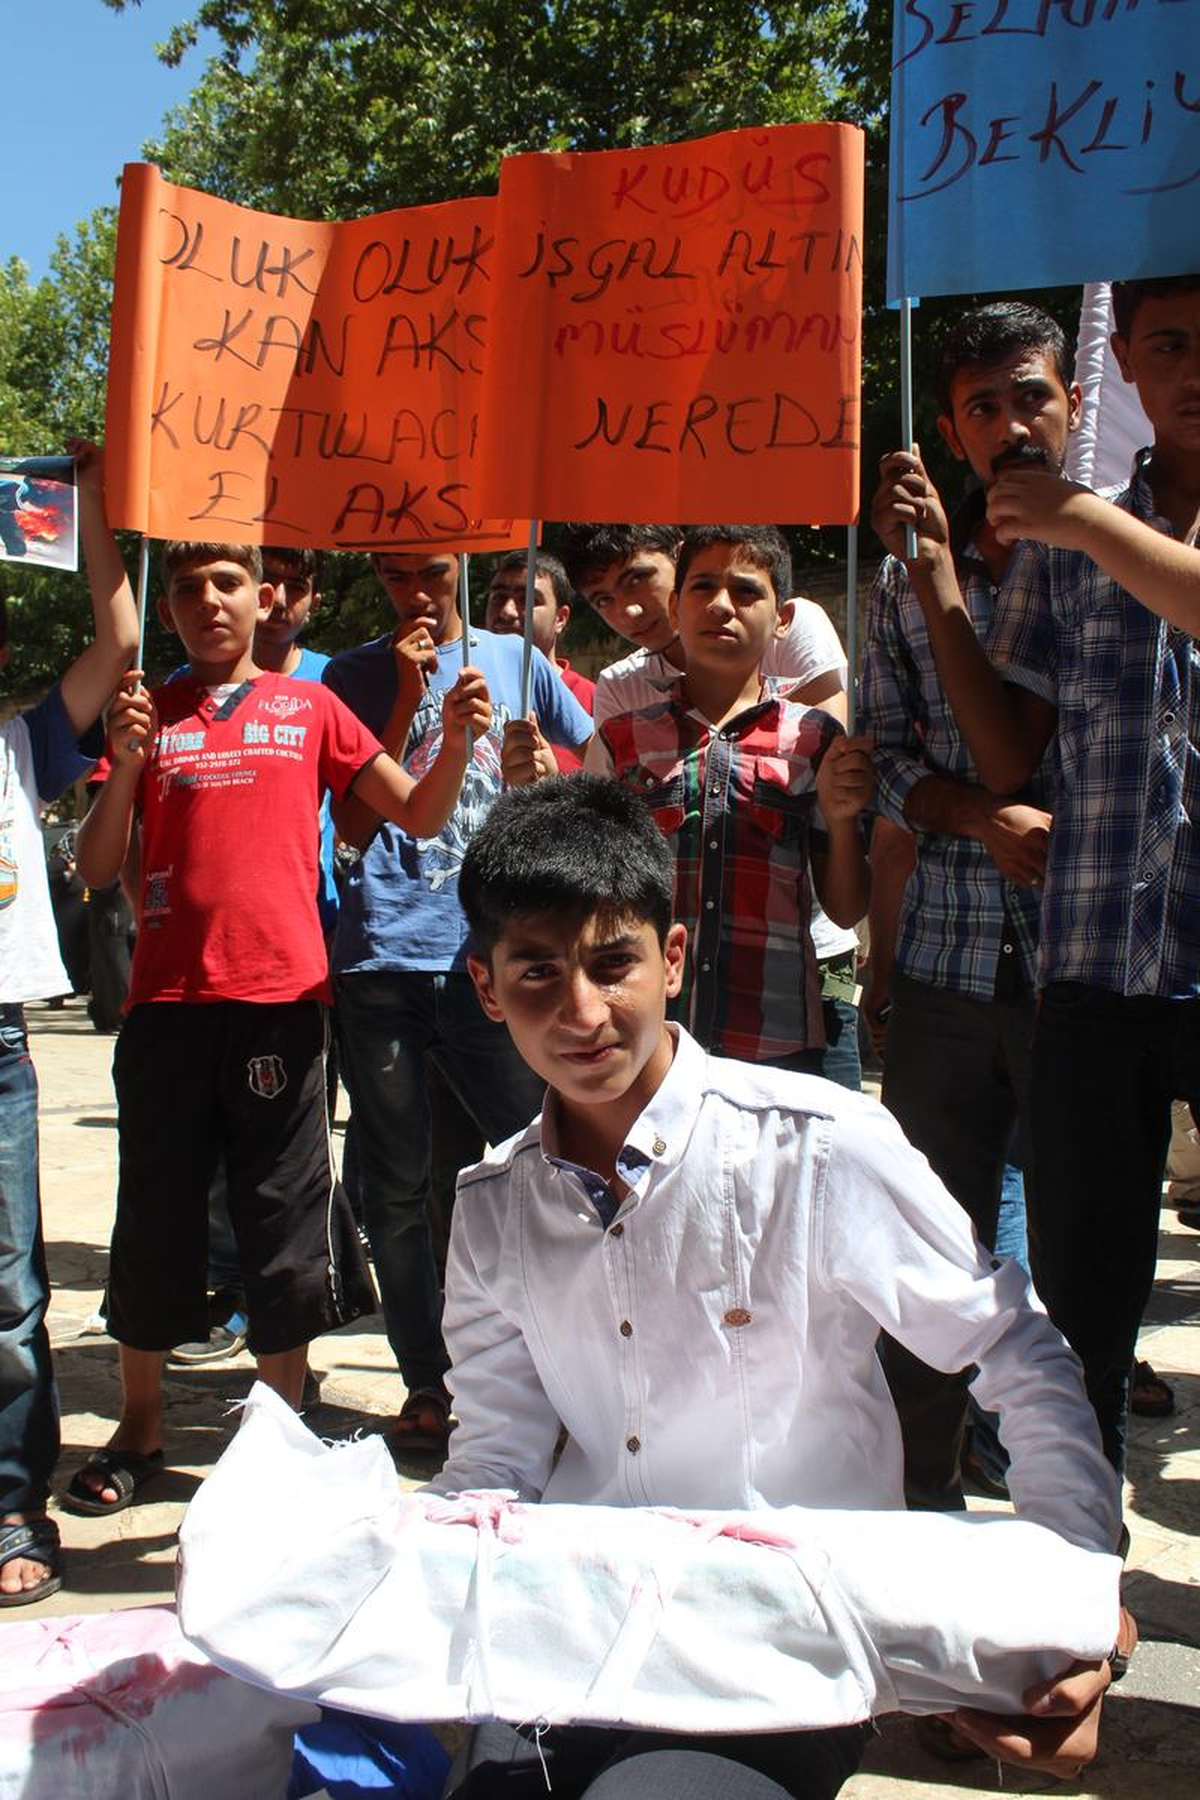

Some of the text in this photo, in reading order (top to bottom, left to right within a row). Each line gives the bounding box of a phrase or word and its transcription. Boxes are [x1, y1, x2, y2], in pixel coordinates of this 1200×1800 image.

[353, 224, 496, 303] OLUK
[193, 308, 356, 377] KAN
[574, 394, 861, 457] NEREDE
[188, 471, 514, 537] EL AKS
[273, 724, 307, 748] CITY
